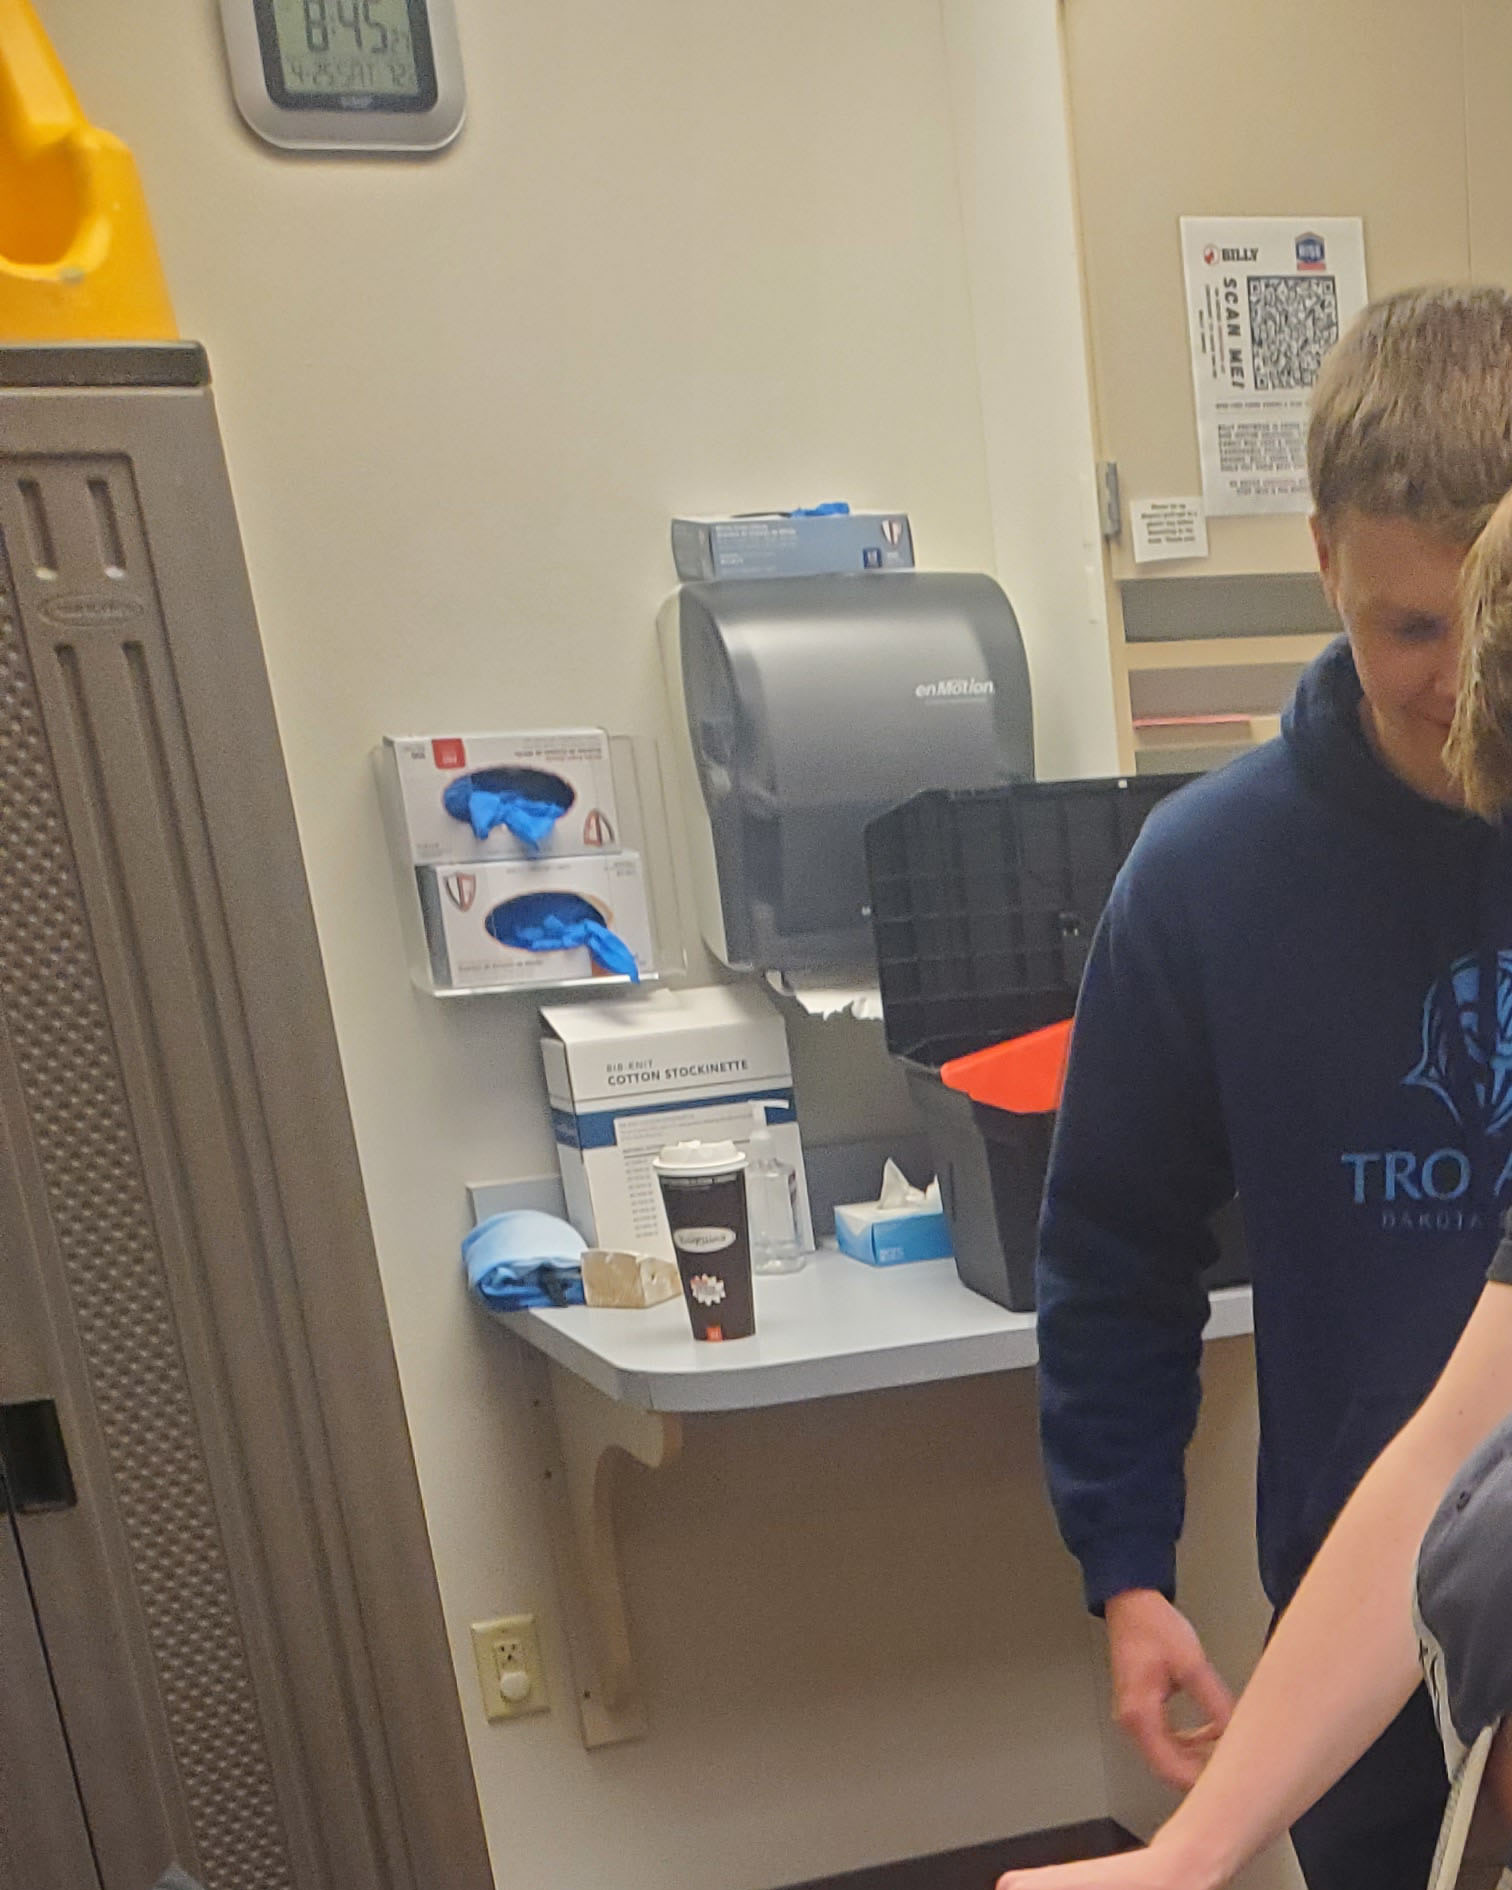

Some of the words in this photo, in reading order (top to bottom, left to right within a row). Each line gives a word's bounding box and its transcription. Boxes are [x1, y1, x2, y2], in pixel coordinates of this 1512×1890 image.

[1222, 248, 1259, 262] BILLY
[1224, 276, 1241, 337] SCAN
[915, 678, 995, 697] enMotion
[607, 1070, 660, 1086] COTTON
[665, 1060, 749, 1080] STOCKINETTE
